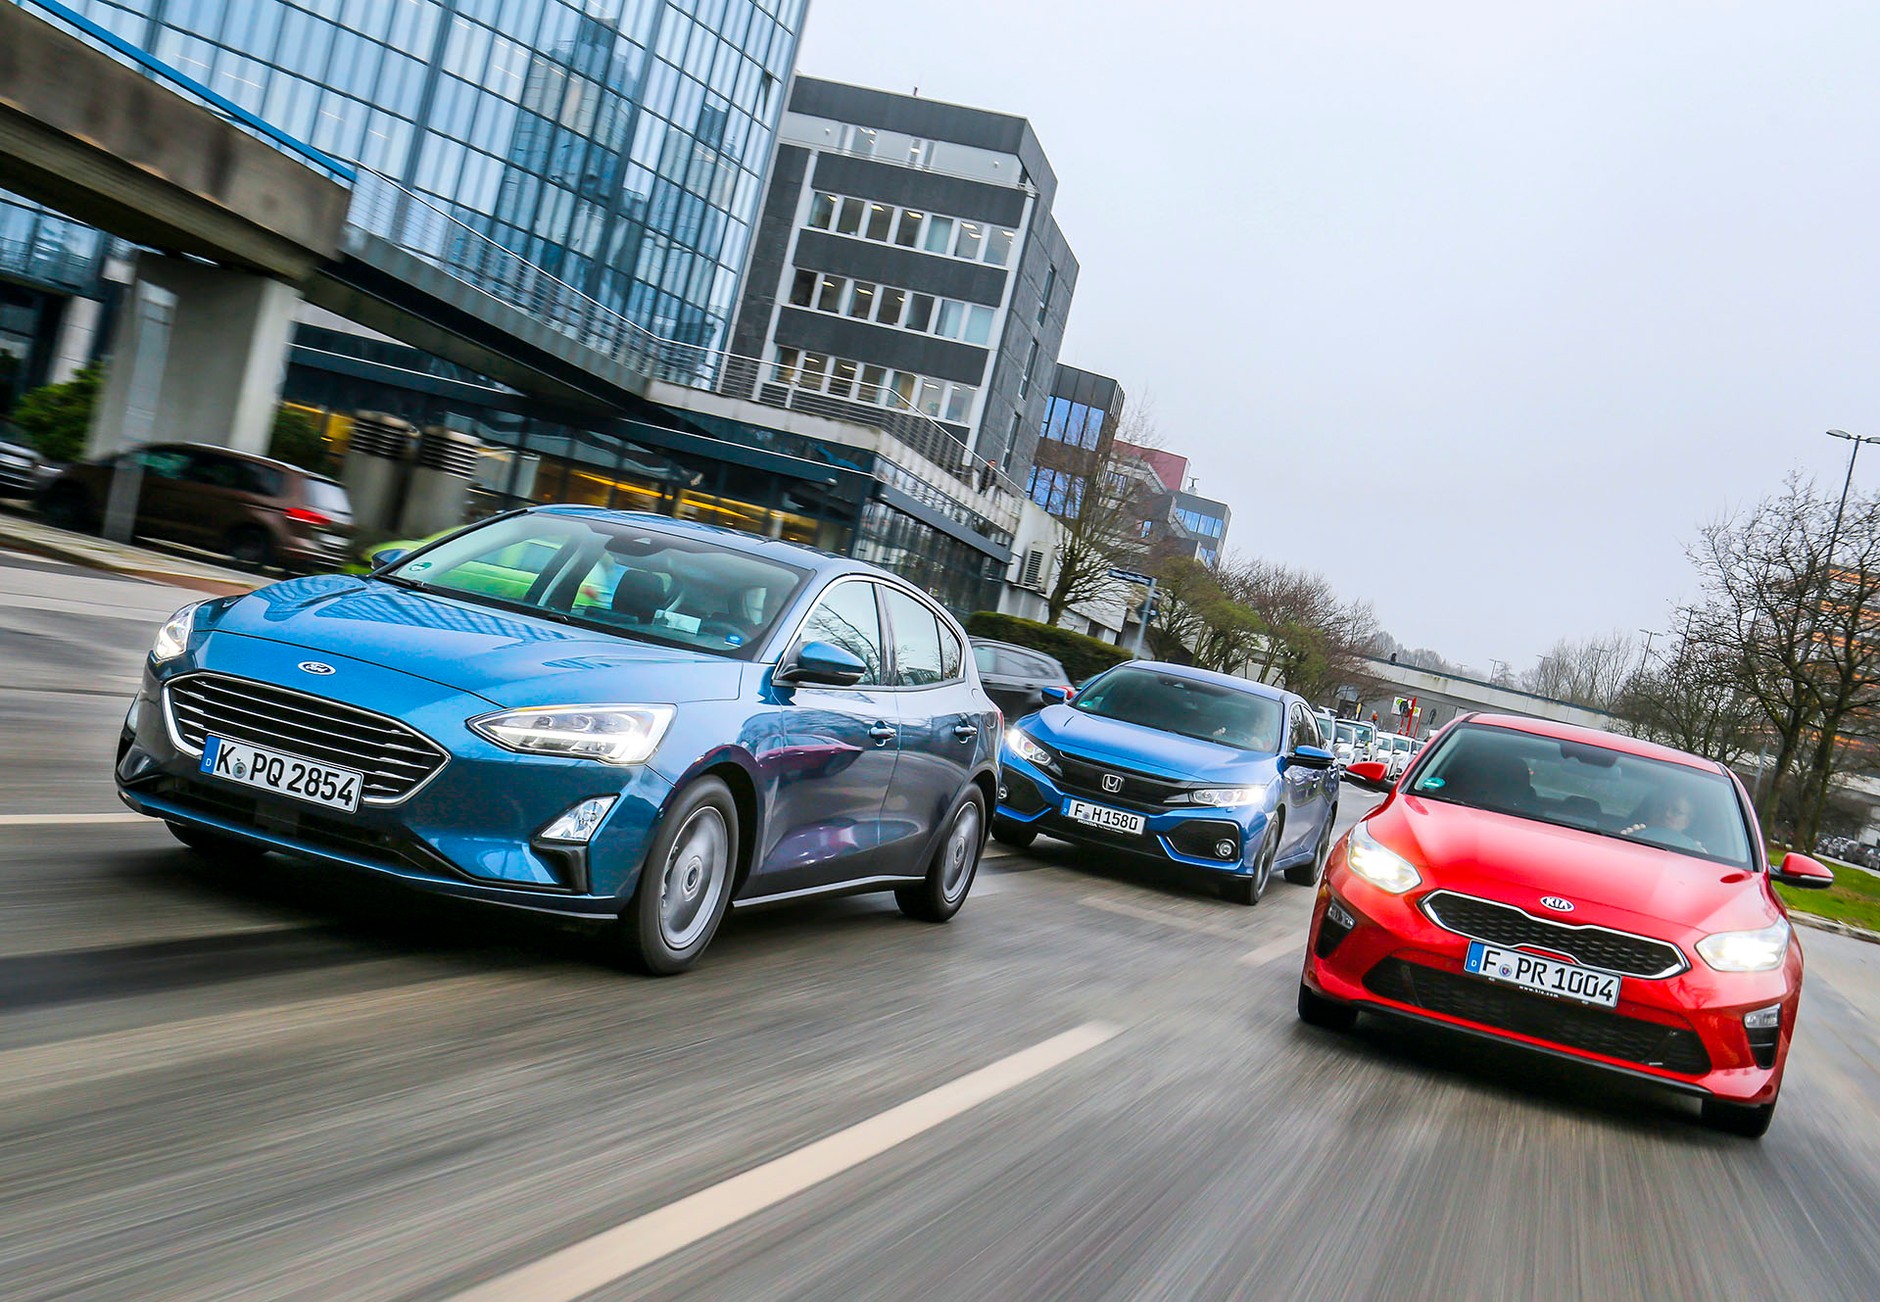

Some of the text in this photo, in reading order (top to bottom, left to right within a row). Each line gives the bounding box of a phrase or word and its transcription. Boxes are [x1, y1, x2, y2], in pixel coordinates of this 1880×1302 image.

[303, 662, 331, 674] Ford
[205, 757, 212, 767] D
[216, 743, 355, 806] K PQ 2854
[1074, 803, 1085, 816] F
[1545, 896, 1569, 910] KIA
[1471, 959, 1477, 967] D
[1482, 950, 1614, 1001] F PR 1004
